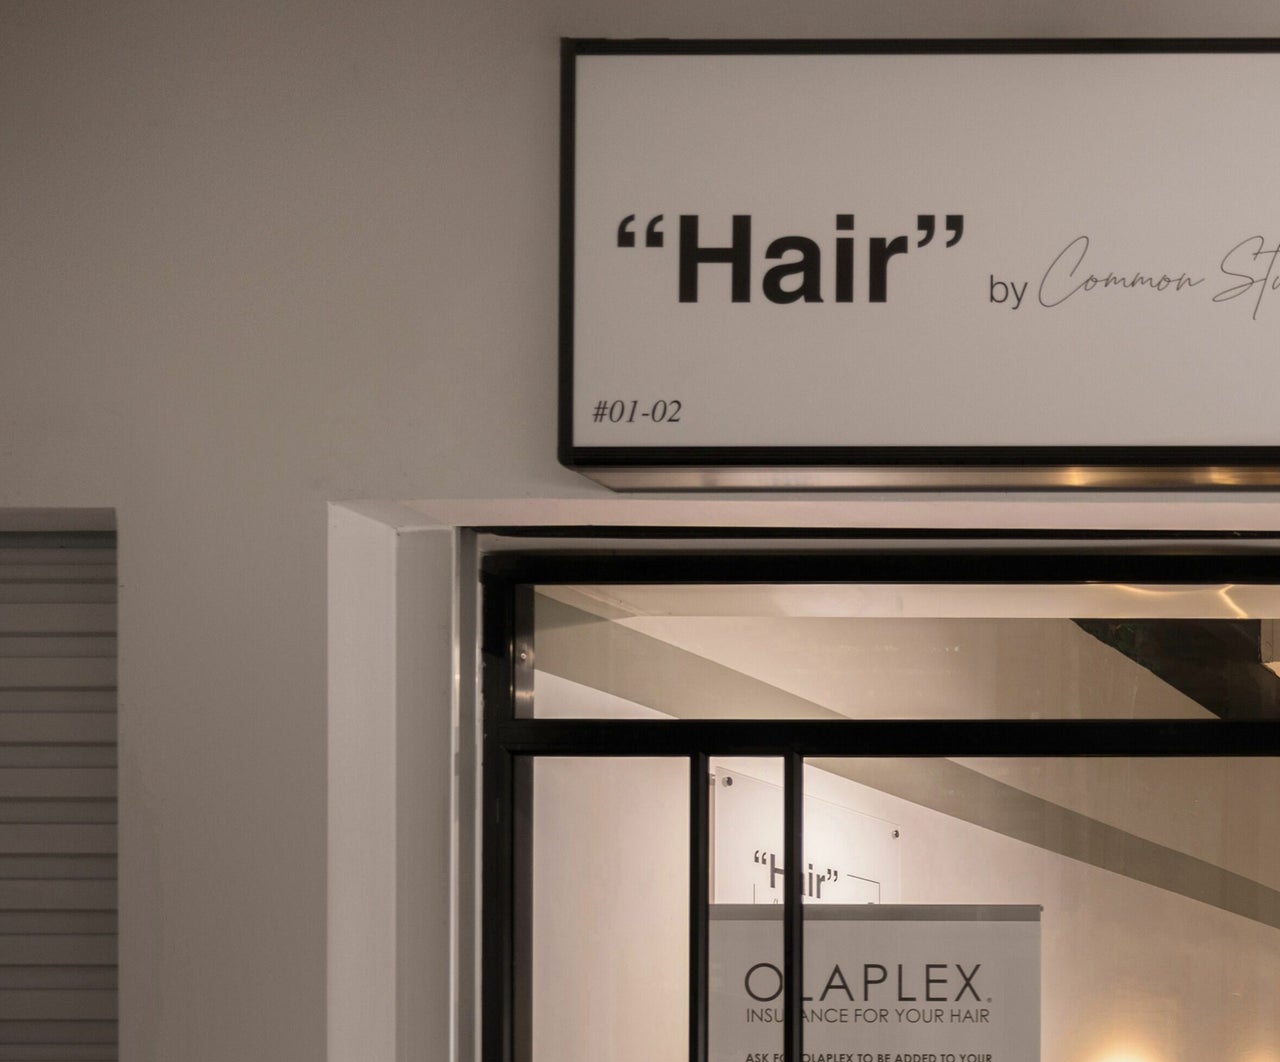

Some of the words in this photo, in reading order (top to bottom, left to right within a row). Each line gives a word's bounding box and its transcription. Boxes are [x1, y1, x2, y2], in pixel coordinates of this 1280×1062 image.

[616, 213, 965, 306] “Hair”
[990, 274, 1029, 311] by
[1038, 236, 1205, 309] Common
[592, 399, 683, 424] #01-02
[754, 850, 838, 899] “Hir”
[746, 1007, 849, 1024] INSUANCE
[854, 1008, 889, 1023] FOR
[895, 1008, 944, 1023] YOUR
[950, 1008, 990, 1023] HAIR
